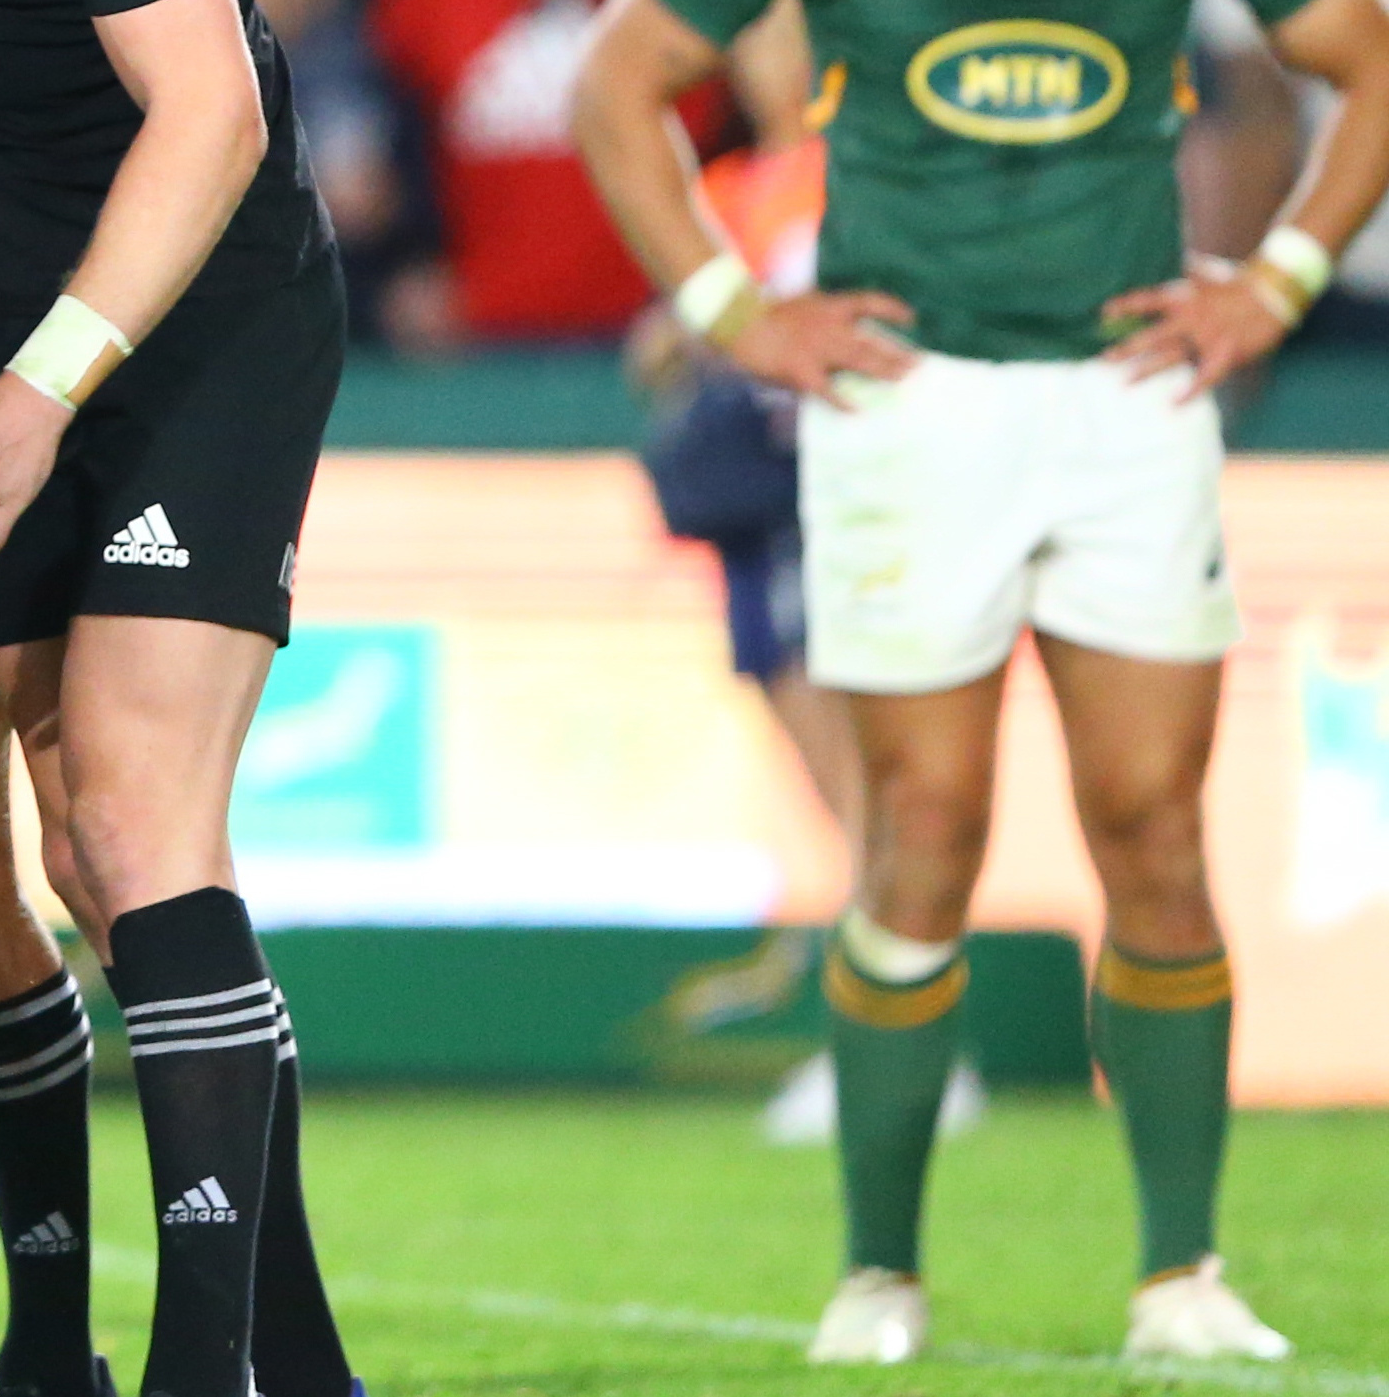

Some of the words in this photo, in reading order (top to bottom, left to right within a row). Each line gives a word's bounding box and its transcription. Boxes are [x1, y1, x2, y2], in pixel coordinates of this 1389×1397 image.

[959, 55, 1083, 107] MTN
[104, 540, 190, 568] adidas
[163, 1208, 238, 1225] adidas
